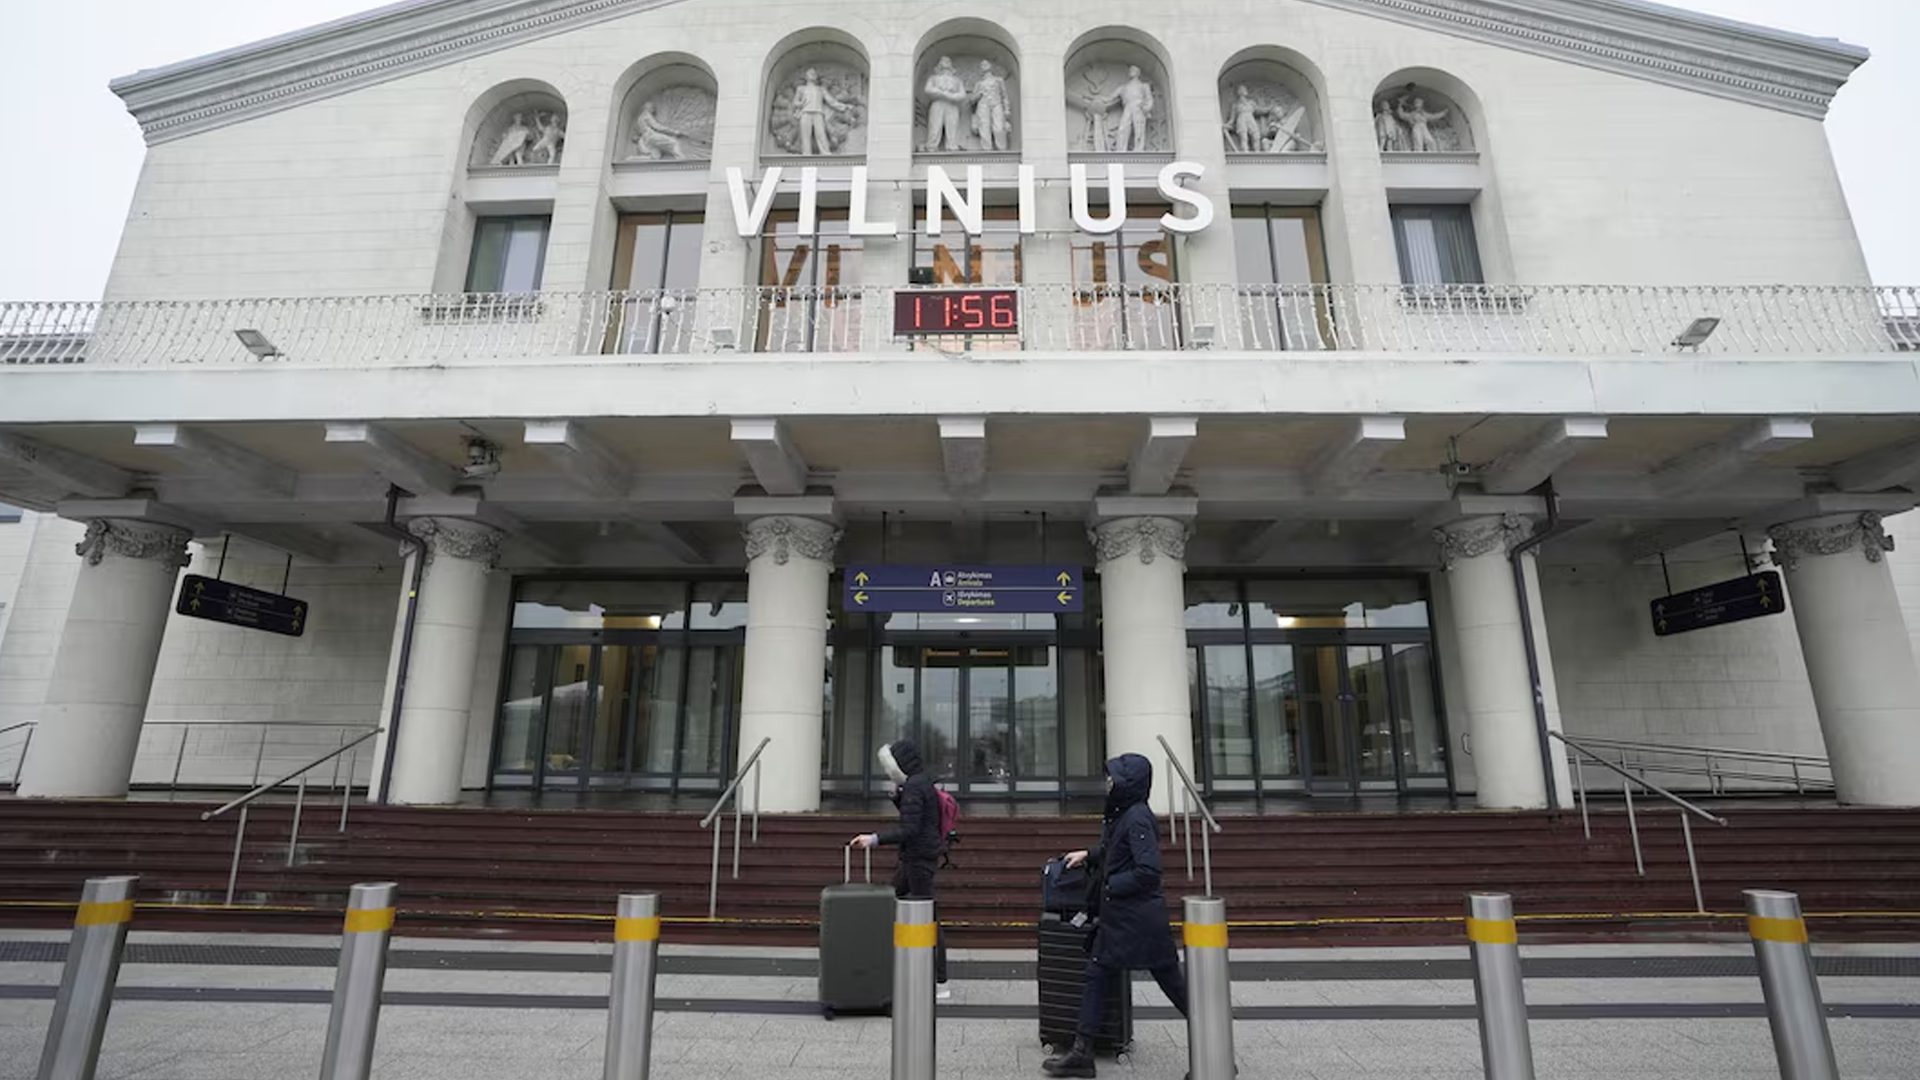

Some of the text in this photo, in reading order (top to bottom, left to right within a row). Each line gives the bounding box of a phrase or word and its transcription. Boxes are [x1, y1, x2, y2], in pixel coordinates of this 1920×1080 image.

[726, 161, 1214, 236] VILNIUS
[914, 295, 1013, 328] 11:56
[930, 571, 941, 586] A
